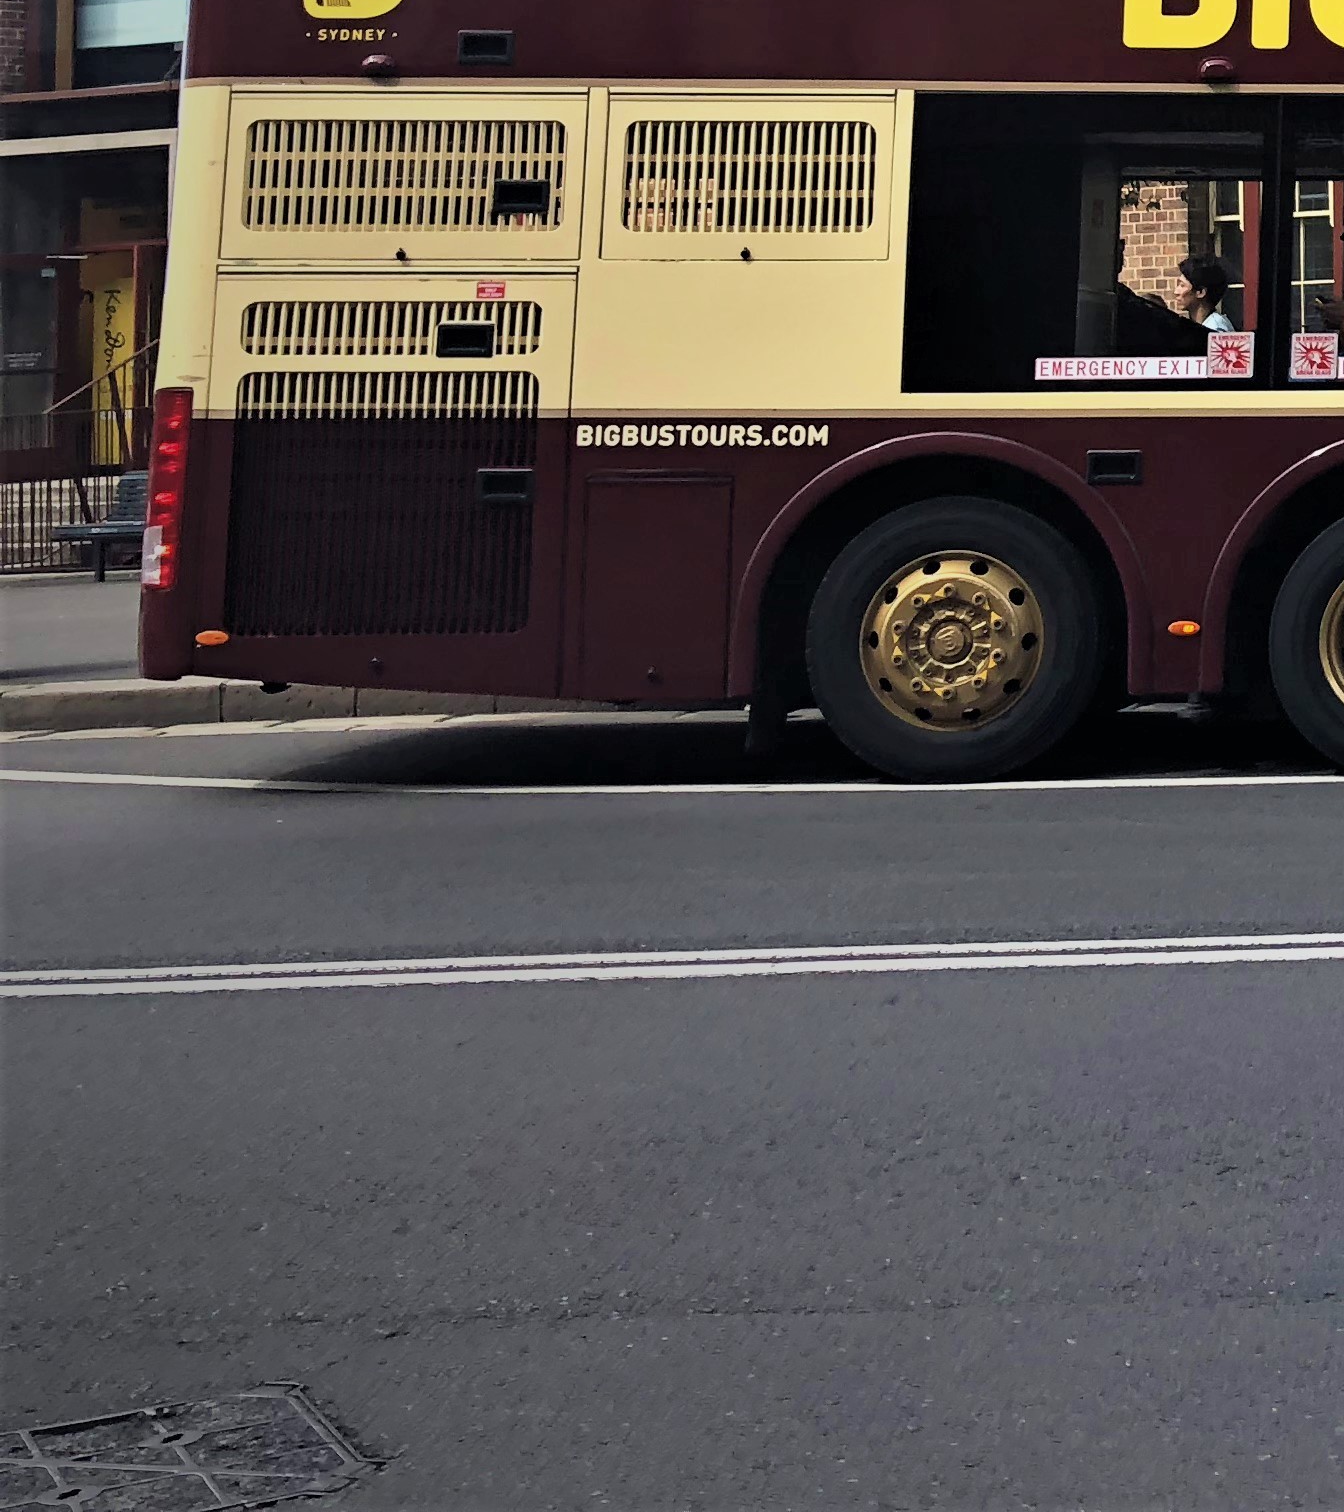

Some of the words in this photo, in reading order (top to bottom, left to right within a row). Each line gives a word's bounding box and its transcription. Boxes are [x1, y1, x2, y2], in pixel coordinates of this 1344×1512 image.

[317, 28, 386, 42] SYDNEY
[1040, 360, 1148, 376] EMERGENCY
[1158, 359, 1205, 375] EXIT
[576, 424, 829, 447] BIGBUSTOURS.COM
